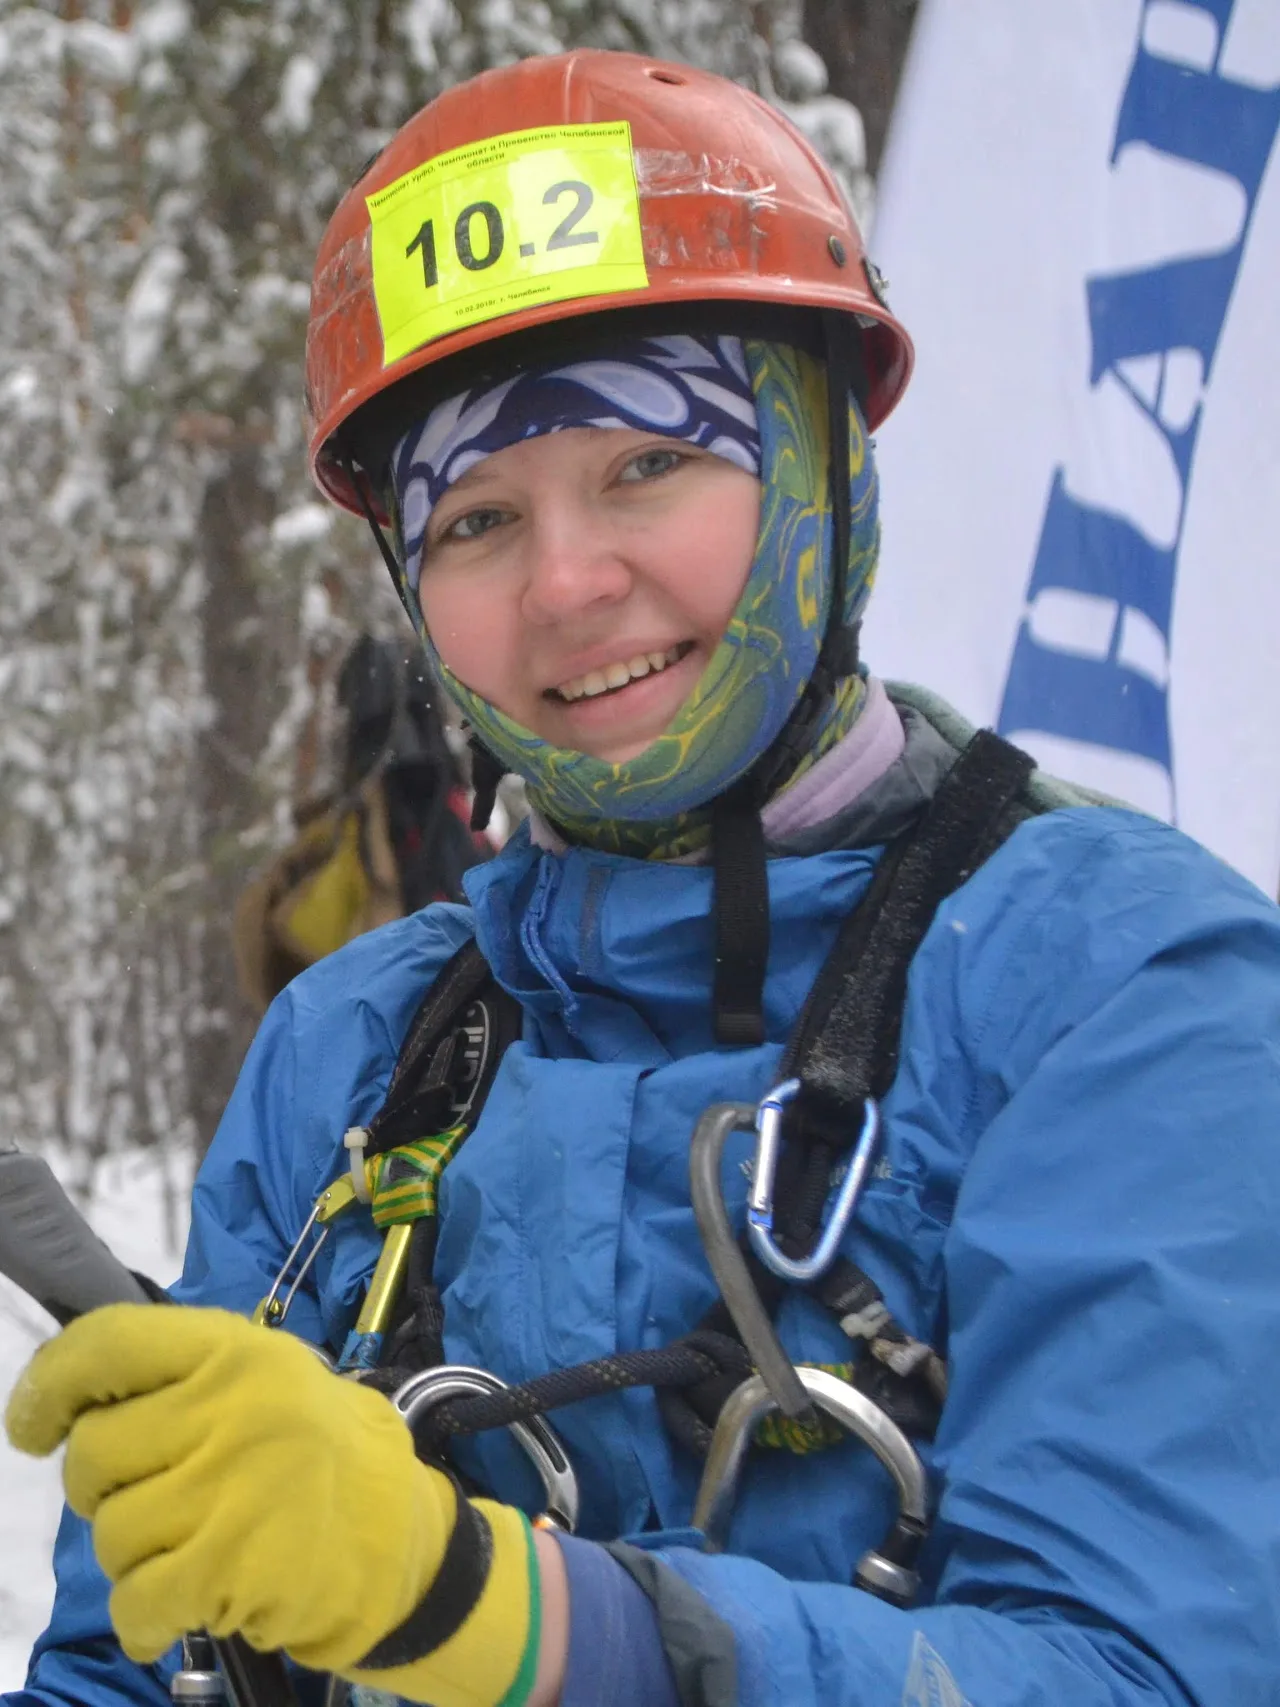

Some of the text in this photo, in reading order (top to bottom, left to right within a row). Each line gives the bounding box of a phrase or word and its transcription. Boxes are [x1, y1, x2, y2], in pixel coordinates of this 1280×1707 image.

[370, 180, 410, 208] Чемпионат
[438, 146, 488, 168] Чемпионат
[490, 144, 497, 152] и
[559, 128, 625, 138] Челябинской
[466, 152, 506, 169] области
[405, 180, 599, 289] 10.2
[508, 285, 551, 300] Челябинск
